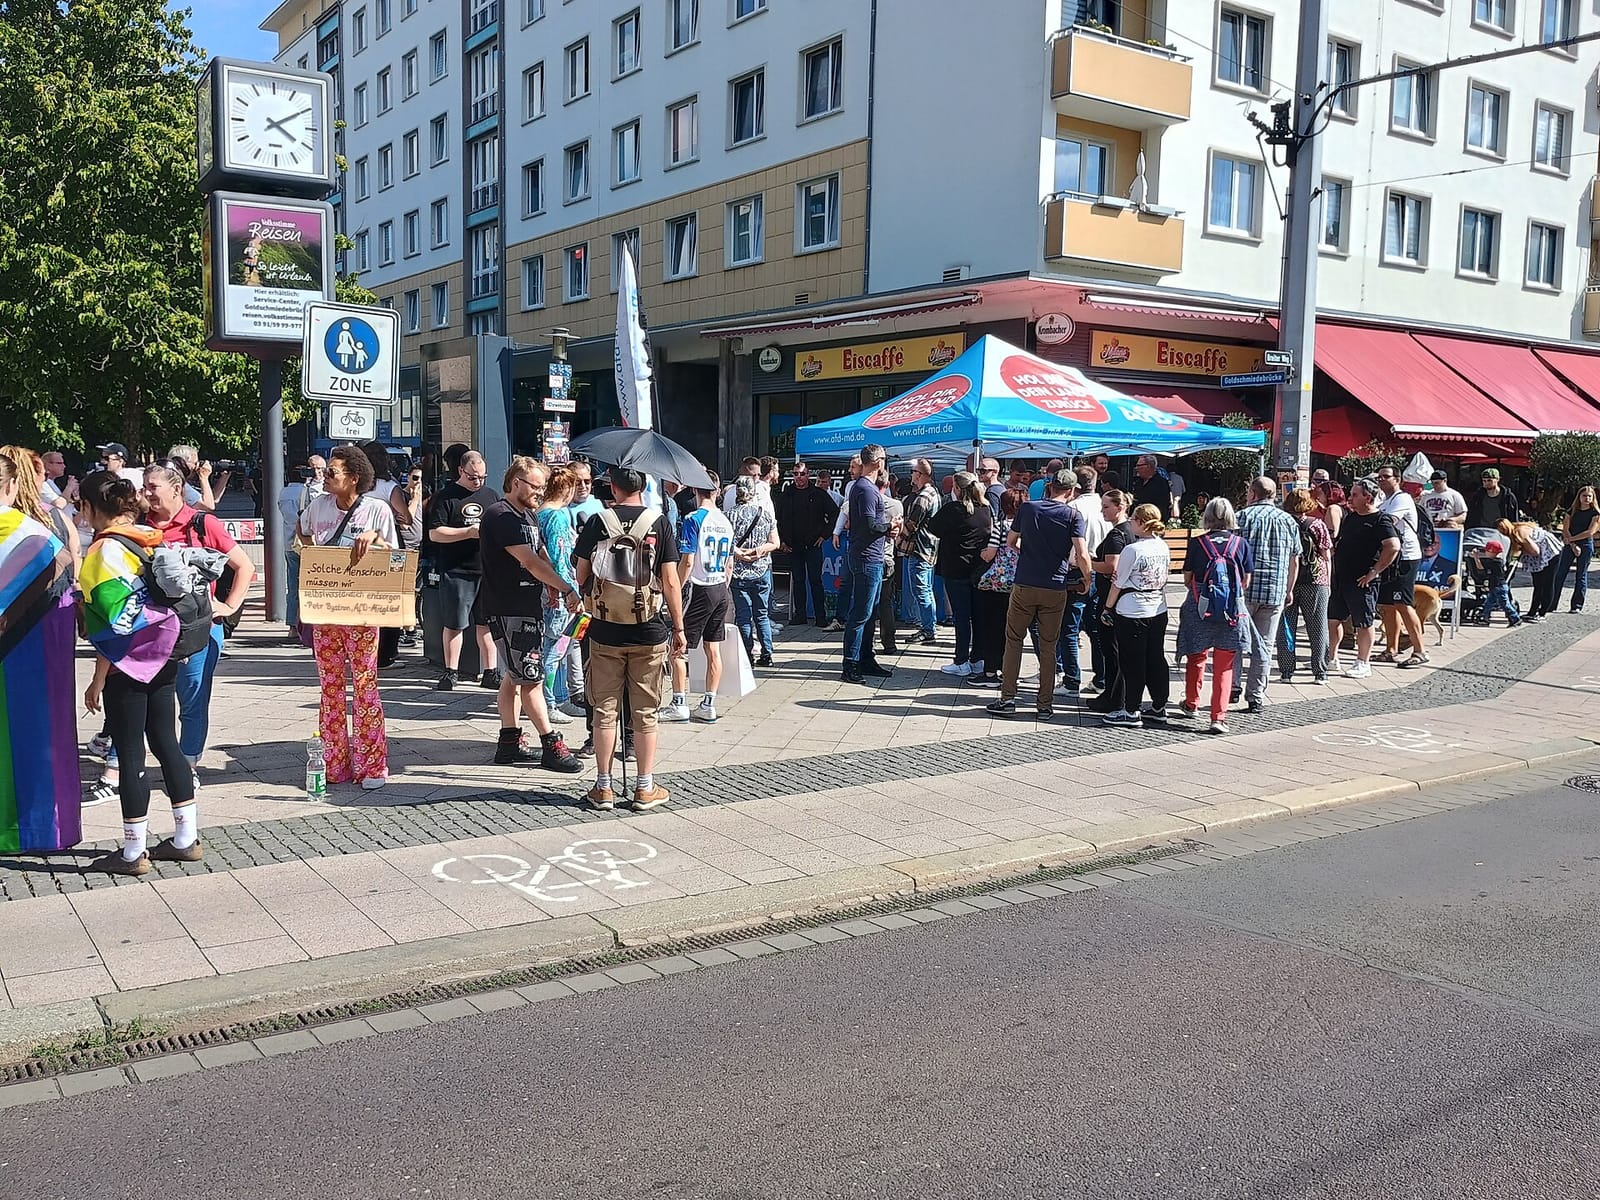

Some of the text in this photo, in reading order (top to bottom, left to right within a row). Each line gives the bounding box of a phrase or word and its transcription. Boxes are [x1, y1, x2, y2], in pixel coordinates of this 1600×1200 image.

[248, 221, 302, 242] Reisen
[256, 261, 267, 271] So
[265, 271, 277, 279] ist
[842, 346, 904, 372] Eiscaffè
[1156, 341, 1228, 373] Eiscaffè
[329, 376, 372, 393] ZONE
[1012, 374, 1045, 385] HOL
[1224, 374, 1283, 385] Goldschmiedebrücke
[899, 388, 958, 405] HOL DIR
[1017, 386, 1053, 397] DEIN
[880, 396, 957, 415] DEIN LAND
[1040, 397, 1096, 409] ZURÜCK
[814, 430, 865, 445] www.afd-md.de
[893, 424, 953, 438] www.afd-md.de
[343, 565, 387, 577] Menschen
[822, 556, 842, 575] Af
[306, 578, 354, 588] müssen wir
